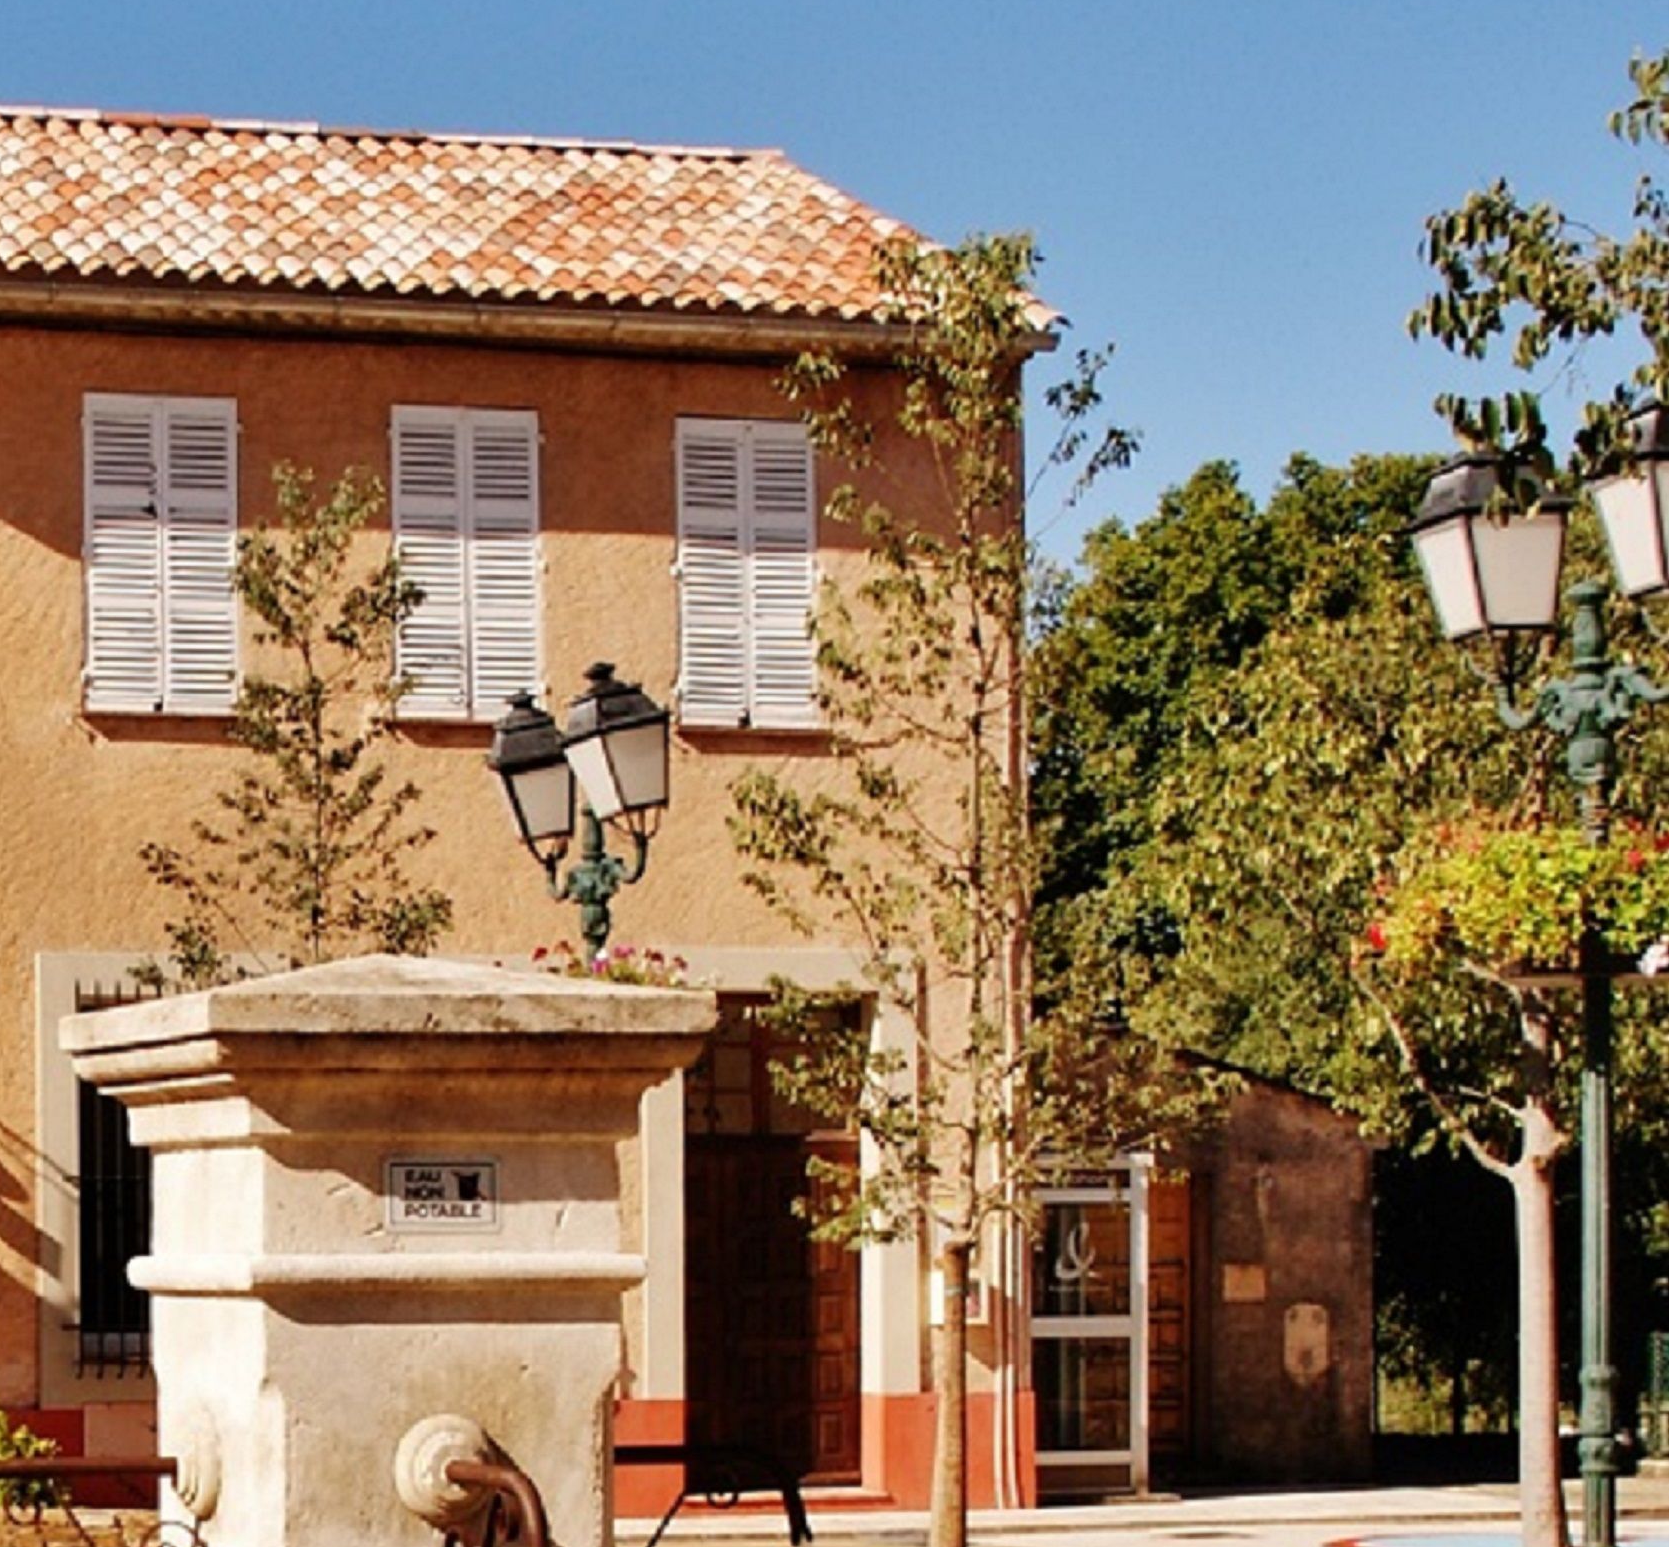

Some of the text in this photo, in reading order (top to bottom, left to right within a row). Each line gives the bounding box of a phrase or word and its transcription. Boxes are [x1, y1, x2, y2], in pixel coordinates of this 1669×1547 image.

[404, 1169, 441, 1182] EAU
[404, 1186, 445, 1200] NON
[404, 1204, 482, 1218] POTABLE
